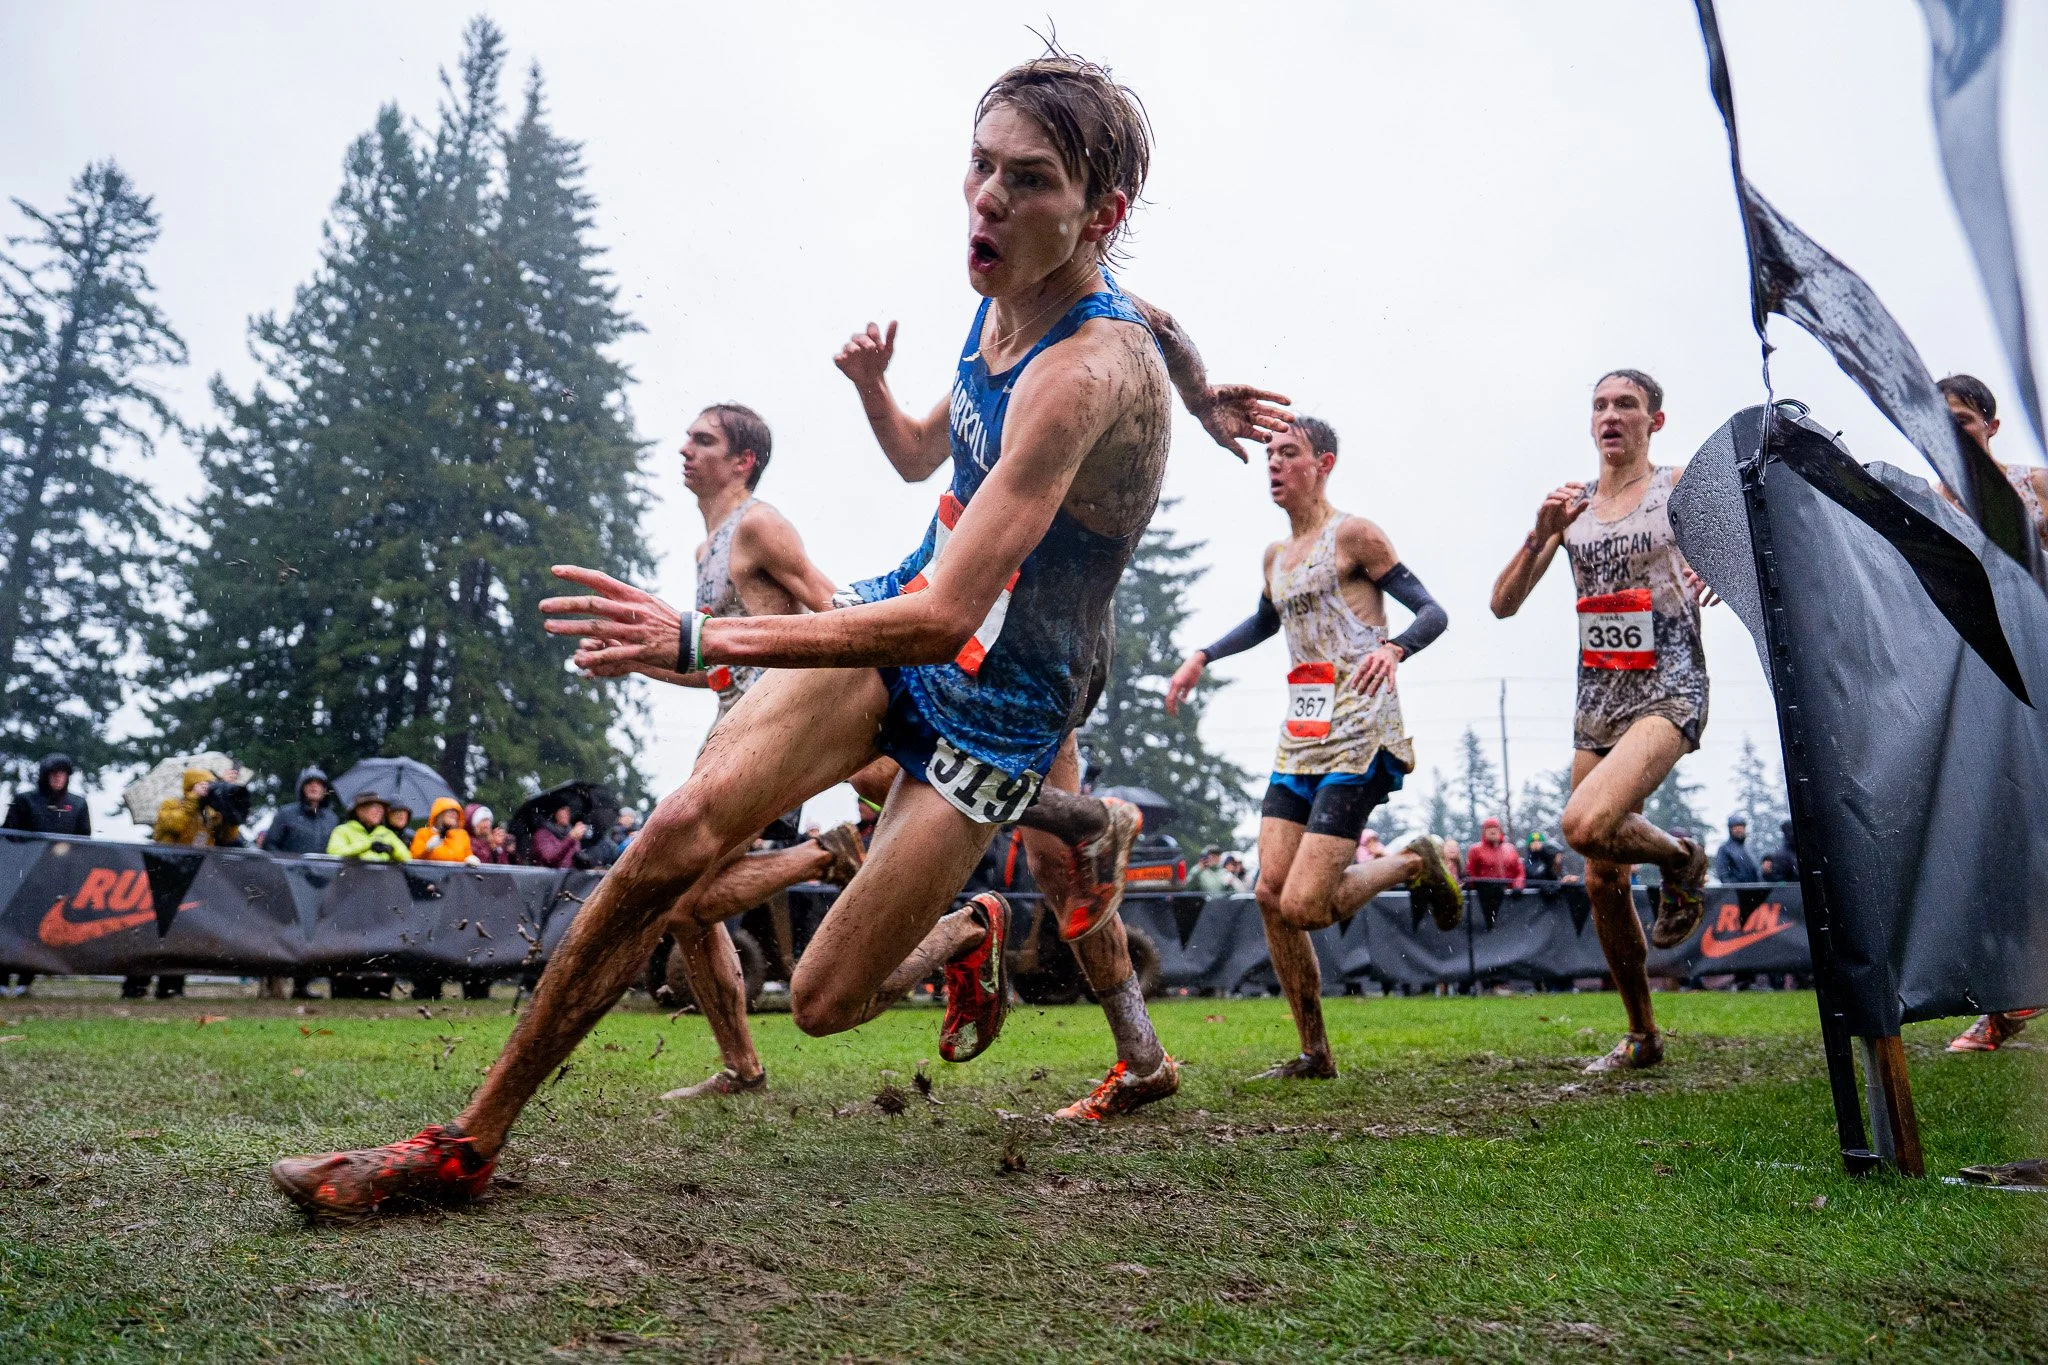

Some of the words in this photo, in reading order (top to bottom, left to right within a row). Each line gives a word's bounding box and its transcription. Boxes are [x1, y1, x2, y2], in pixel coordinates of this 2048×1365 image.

[949, 370, 989, 474] ARROLL
[1572, 531, 1652, 561] AMERICAN
[1594, 557, 1630, 583] FORK
[1587, 625, 1642, 649] 336
[1295, 697, 1327, 718] 367
[71, 867, 154, 911] RU
